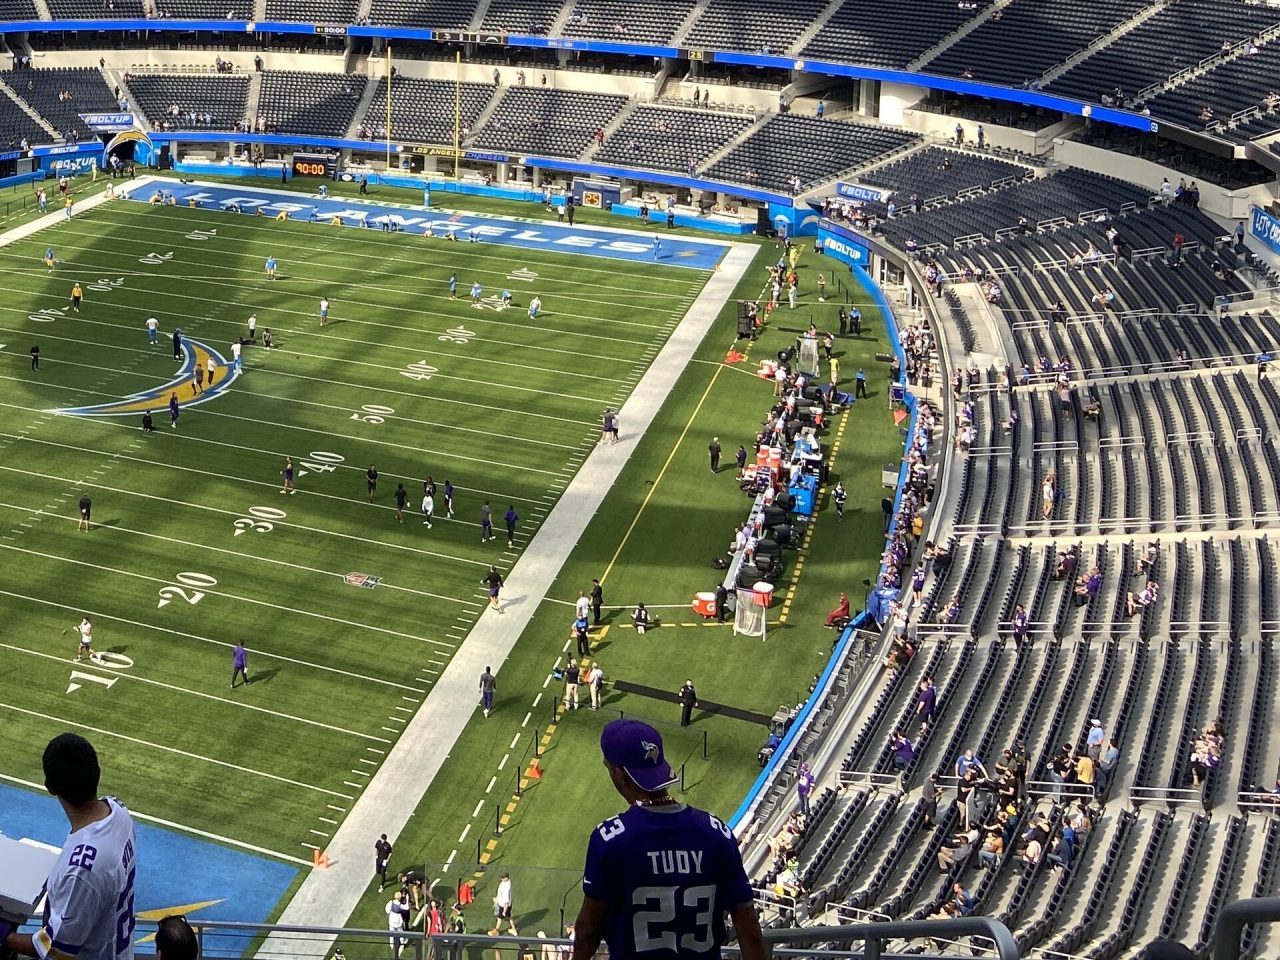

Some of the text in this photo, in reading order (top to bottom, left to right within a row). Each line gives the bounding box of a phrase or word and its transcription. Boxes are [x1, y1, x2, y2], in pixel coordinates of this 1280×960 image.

[325, 26, 345, 34] 90:00
[690, 50, 702, 59] 25
[85, 114, 130, 124] #BOLTUP
[412, 146, 510, 163] LOS ANGELES CHARGERS
[296, 162, 325, 175] 90:00
[585, 193, 599, 205] 25
[841, 185, 881, 201] #BOLTU
[182, 192, 653, 253] LOS ANGELES
[185, 228, 217, 240] 10
[138, 251, 174, 264] 20
[825, 238, 861, 260] #BOLTUP
[86, 277, 125, 292] 30
[28, 306, 70, 322] 40
[437, 327, 476, 344] 30
[399, 362, 439, 381] 40
[350, 404, 395, 424] 50
[298, 451, 345, 473] 40
[232, 506, 287, 533] 30
[158, 571, 218, 605] 20
[69, 651, 134, 688] 10
[597, 815, 626, 842] 3
[709, 815, 732, 840] 2
[68, 843, 97, 872] 22
[647, 850, 703, 875] TUDY
[632, 884, 717, 954] 23
